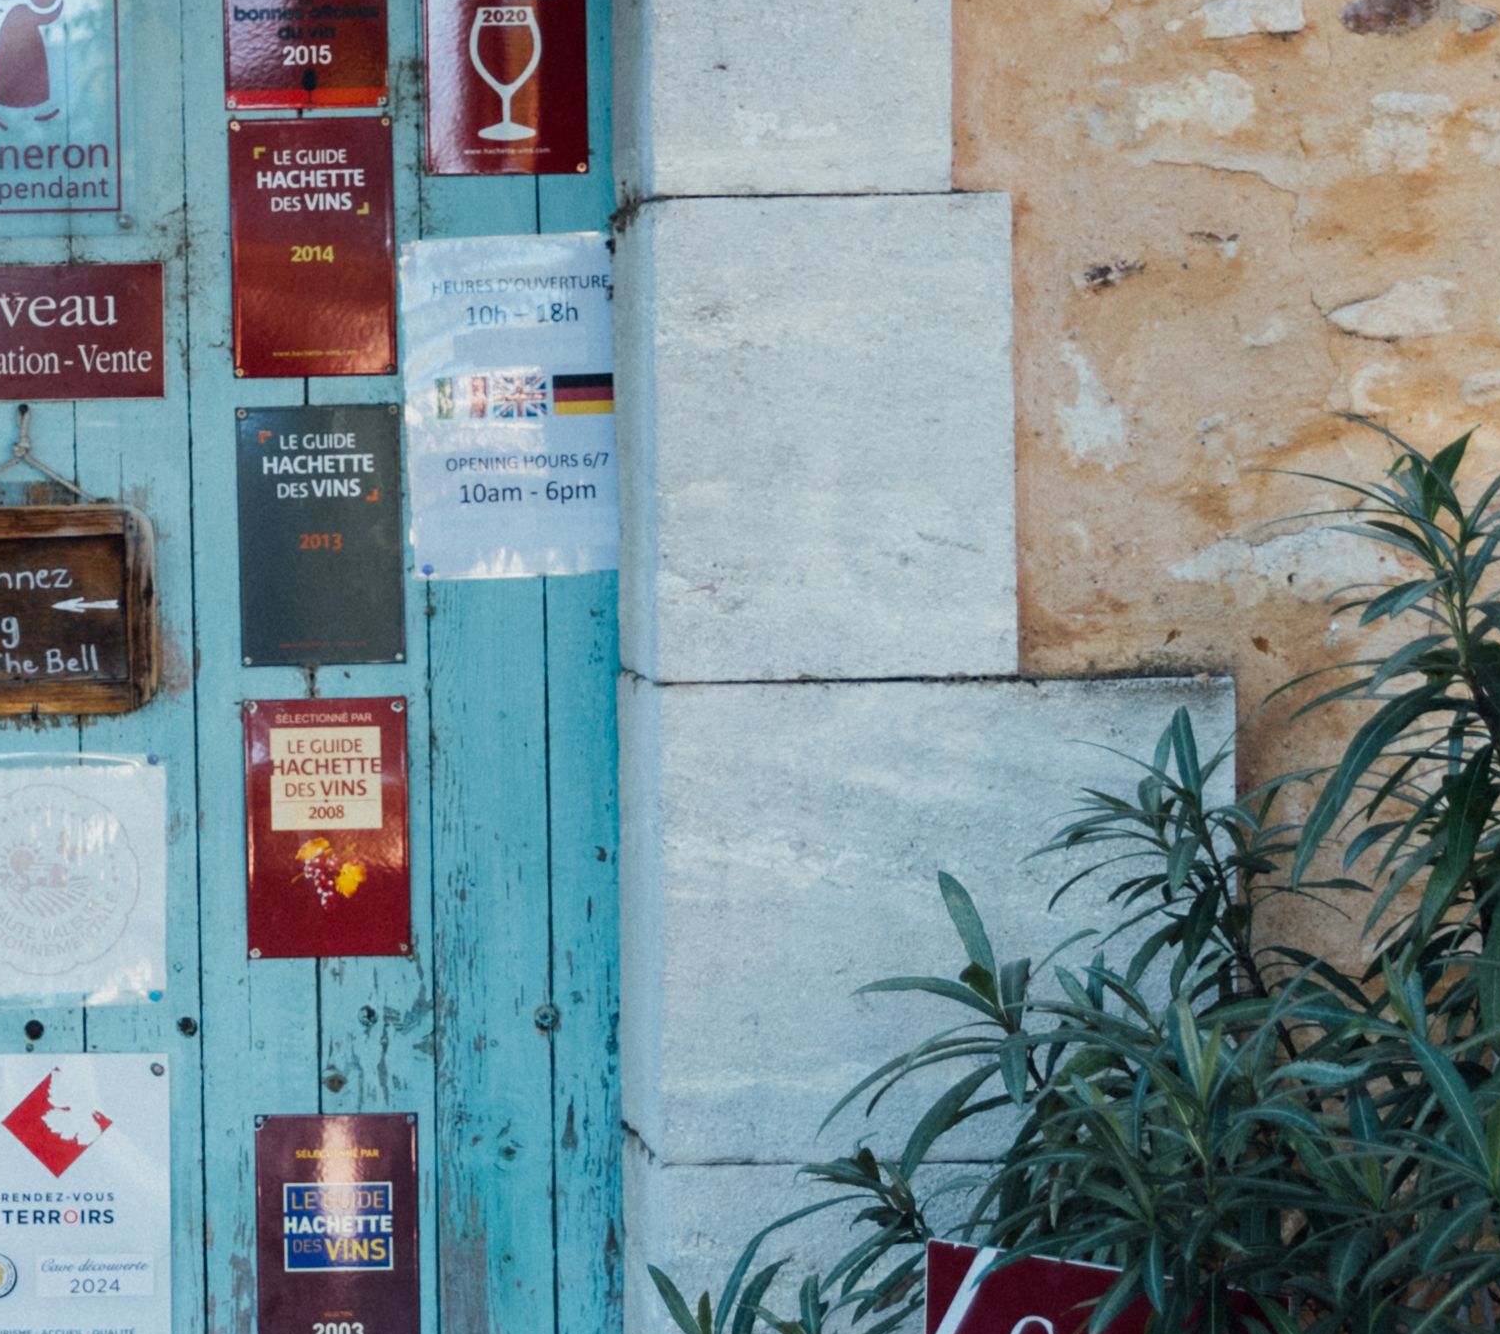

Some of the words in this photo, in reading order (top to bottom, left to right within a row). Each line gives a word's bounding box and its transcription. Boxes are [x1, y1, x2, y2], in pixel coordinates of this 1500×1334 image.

[483, 10, 527, 23] 2020
[283, 46, 332, 65] 2015
[274, 151, 290, 165] LE
[296, 149, 347, 164] GUIDE
[257, 170, 365, 189] HACHETTE
[271, 197, 300, 212] DES
[304, 193, 352, 210] VINS
[291, 246, 334, 262] 2014
[432, 277, 493, 295] HEURES
[500, 275, 609, 291] D'OUVERTURE
[467, 306, 506, 325] 10h
[538, 303, 578, 323] 18h
[280, 435, 298, 450] LE
[303, 433, 355, 449] GUIDE
[263, 454, 374, 475] HACHETTE
[446, 456, 518, 471] OPENING
[524, 454, 578, 468] HOURS
[583, 452, 609, 468] 6/7
[277, 483, 308, 498] DES
[312, 479, 361, 497] VINS
[460, 483, 521, 504] 10am
[546, 482, 596, 504] 6pm
[299, 533, 343, 551] 2013
[46, 644, 99, 673] Bell
[275, 712, 348, 724] SÉLECTIONNÉ
[351, 713, 372, 722] PAR
[288, 740, 304, 754] LE
[310, 739, 362, 753] GUIDE
[271, 758, 382, 776] HACHETTE
[285, 783, 315, 798] DES
[321, 780, 366, 796] VINS
[309, 805, 344, 819] 2008
[361, 1149, 379, 1158] PAR
[2, 1192, 114, 1201] RENDEZ-VOUS
[291, 1192, 316, 1210] LE
[324, 1191, 384, 1209] GUIDE
[2, 1209, 114, 1224] TERROIRS
[284, 1215, 393, 1234] HACHETTE
[293, 1239, 322, 1253] DES
[325, 1239, 386, 1261] VINS
[41, 1258, 72, 1272] Cave
[70, 1278, 120, 1293] 2024
